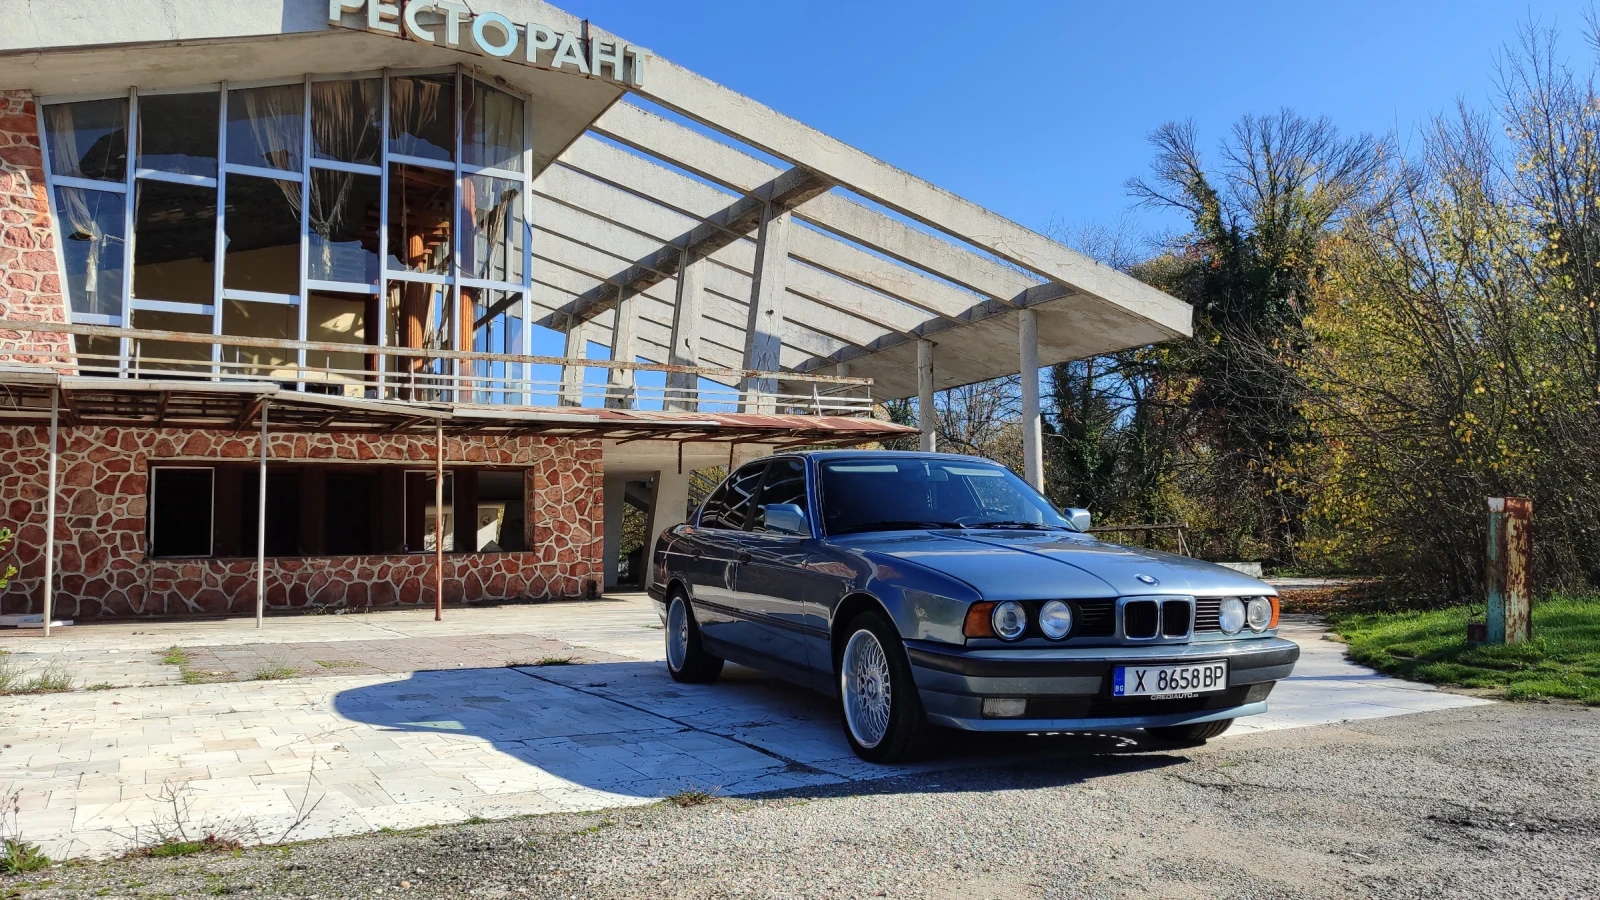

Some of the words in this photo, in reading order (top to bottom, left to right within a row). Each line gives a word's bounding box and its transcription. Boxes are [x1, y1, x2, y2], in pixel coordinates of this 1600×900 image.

[1135, 670, 1147, 692] X
[1158, 668, 1200, 690] 8658
[1203, 666, 1223, 687] BP
